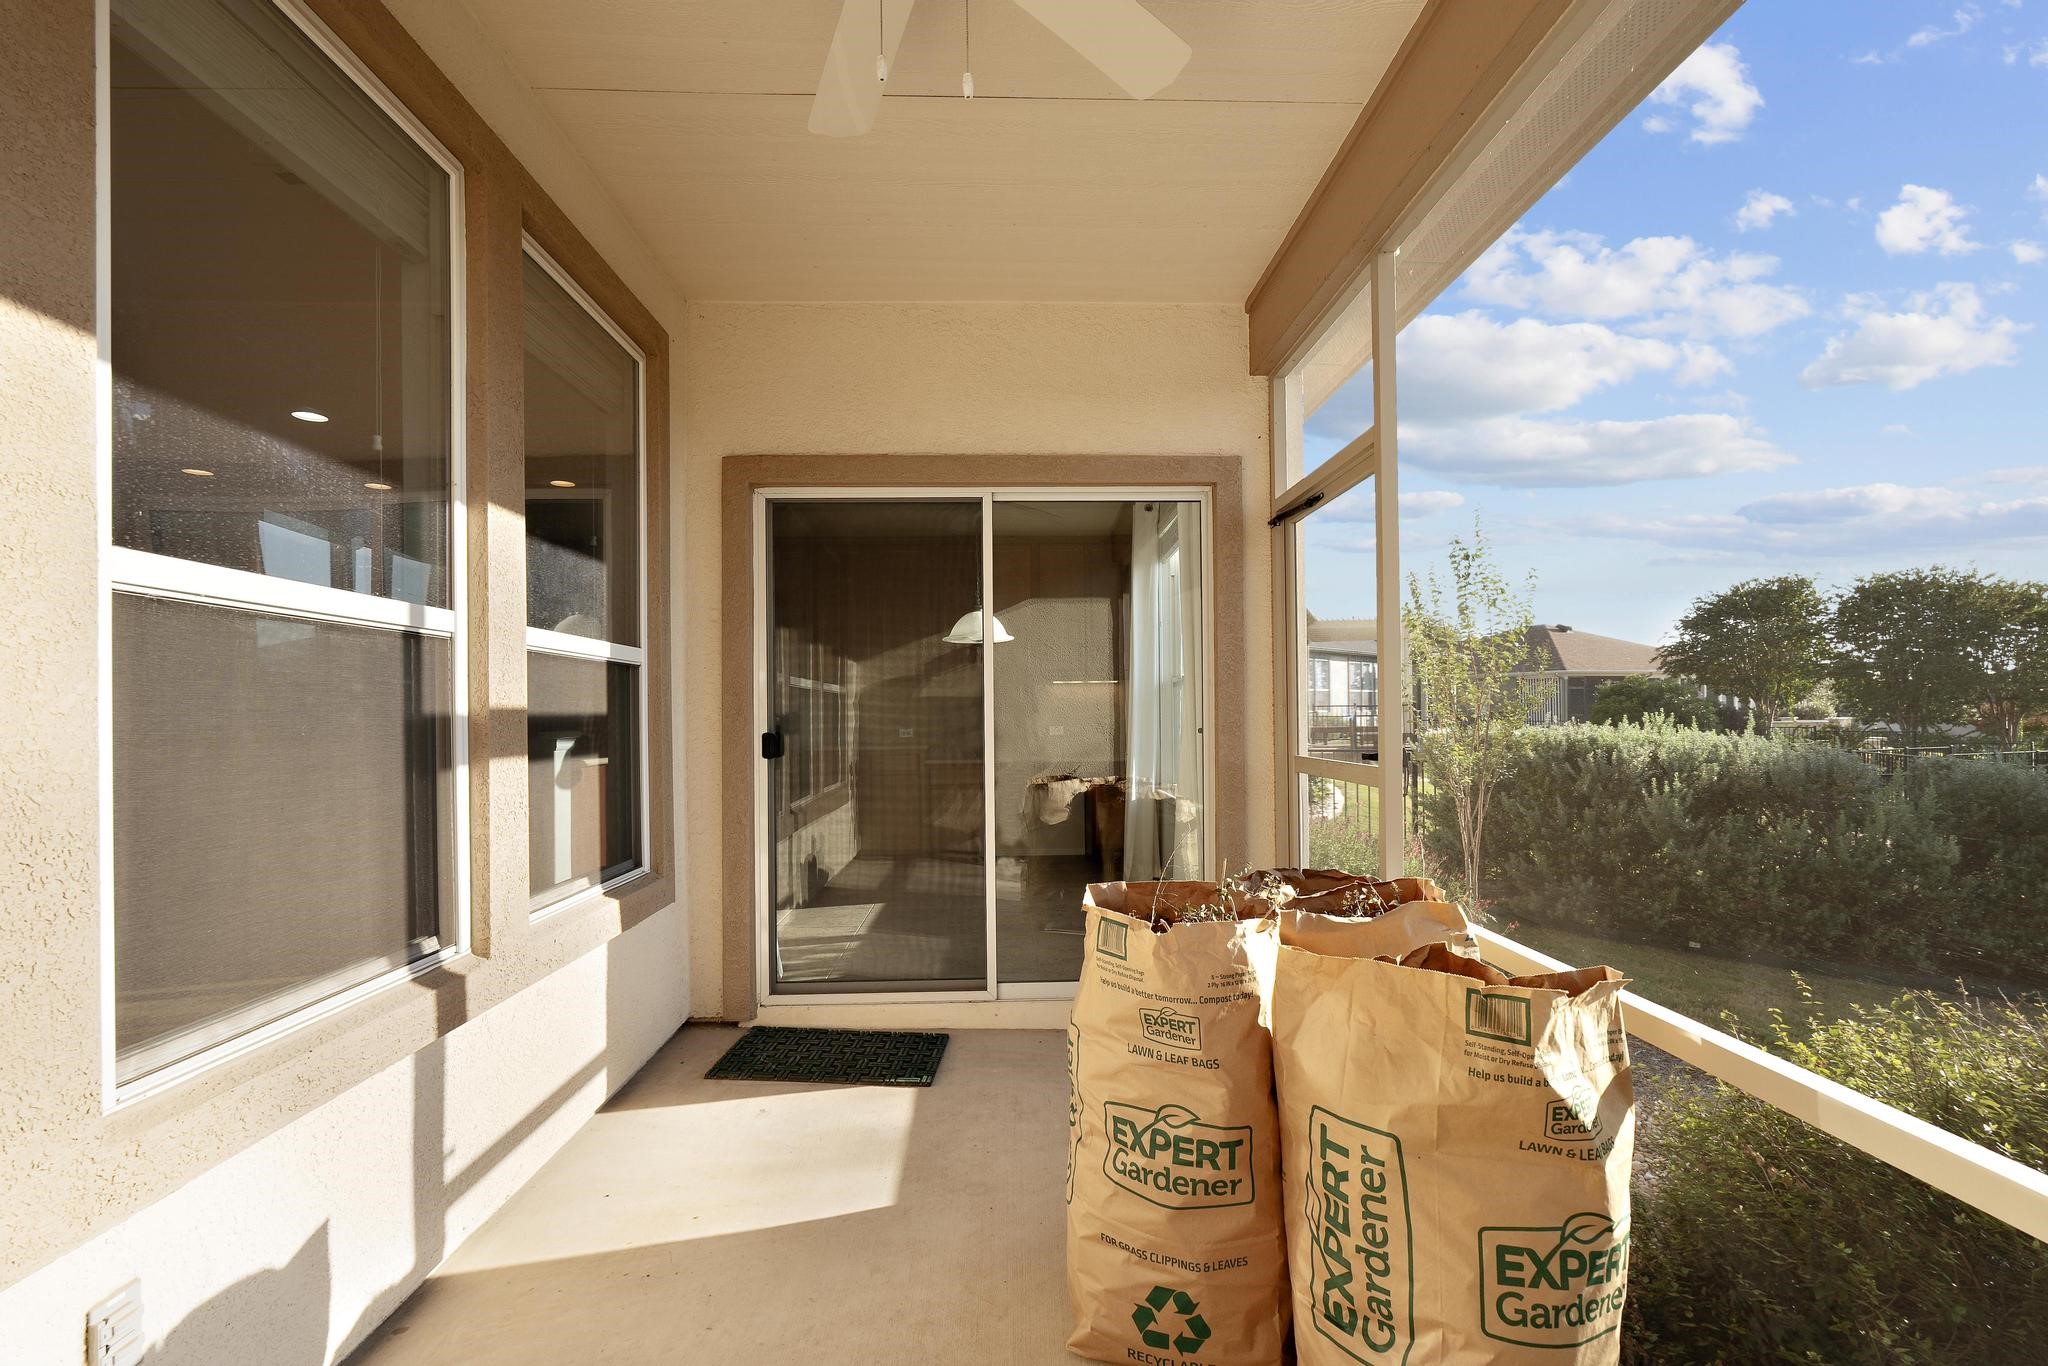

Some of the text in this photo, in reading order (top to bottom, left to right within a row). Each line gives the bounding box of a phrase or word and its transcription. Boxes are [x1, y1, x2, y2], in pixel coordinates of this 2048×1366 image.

[1135, 987, 1154, 1000] better
[1155, 993, 1198, 1005] tomorrow...
[1199, 995, 1232, 1005] Compost
[1233, 989, 1254, 1000] today!
[1143, 1012, 1196, 1034] EXPERT
[1146, 1025, 1196, 1045] Gardener
[1127, 1042, 1220, 1070] LAWN & LEAF BAGS
[1498, 1056, 1511, 1066] Dry
[1512, 1059, 1534, 1069] Refuse
[1507, 1048, 1537, 1062] Self-Ope
[1468, 1066, 1491, 1081] Help
[1493, 1074, 1505, 1083] us
[1507, 1073, 1533, 1086] build
[1112, 1114, 1244, 1171] EXPERT
[1519, 1140, 1563, 1156] LAWN
[1566, 1149, 1576, 1158] &
[1112, 1147, 1243, 1197] Gardener
[1320, 1122, 1359, 1337] EXPERT
[1100, 1232, 1249, 1273] FOR GRASS CLIPPINGS & LEAVES
[1355, 1143, 1396, 1354] Gardener
[1496, 1284, 1625, 1329] Gardene
[1127, 1347, 1217, 1366] RECYCLA
